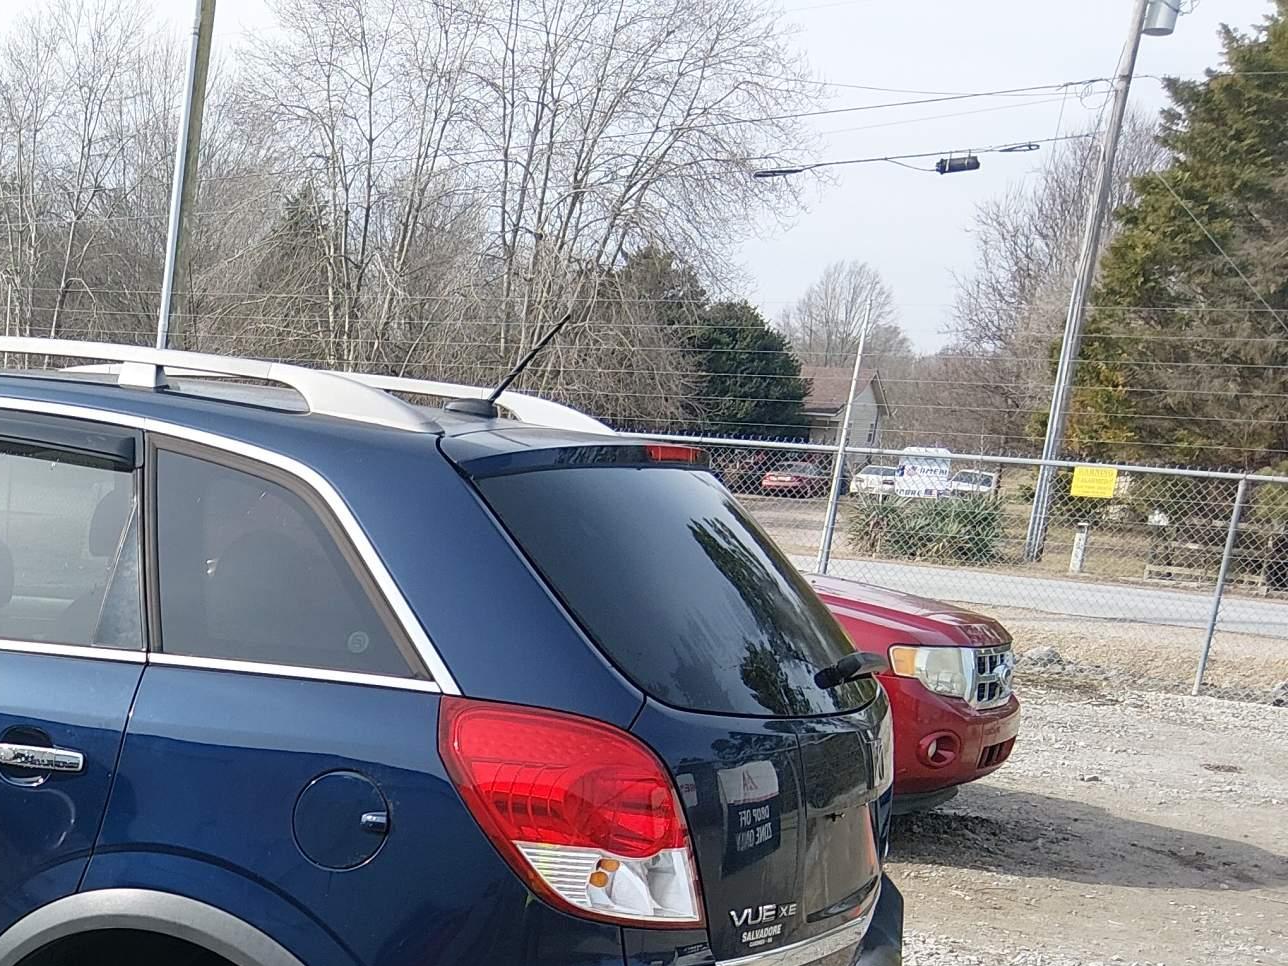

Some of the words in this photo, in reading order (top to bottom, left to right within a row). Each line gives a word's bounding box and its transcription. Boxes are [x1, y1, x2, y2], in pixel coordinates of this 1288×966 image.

[730, 904, 777, 928] VUE
[779, 903, 797, 917] XE
[742, 924, 783, 943] SALVADORE
